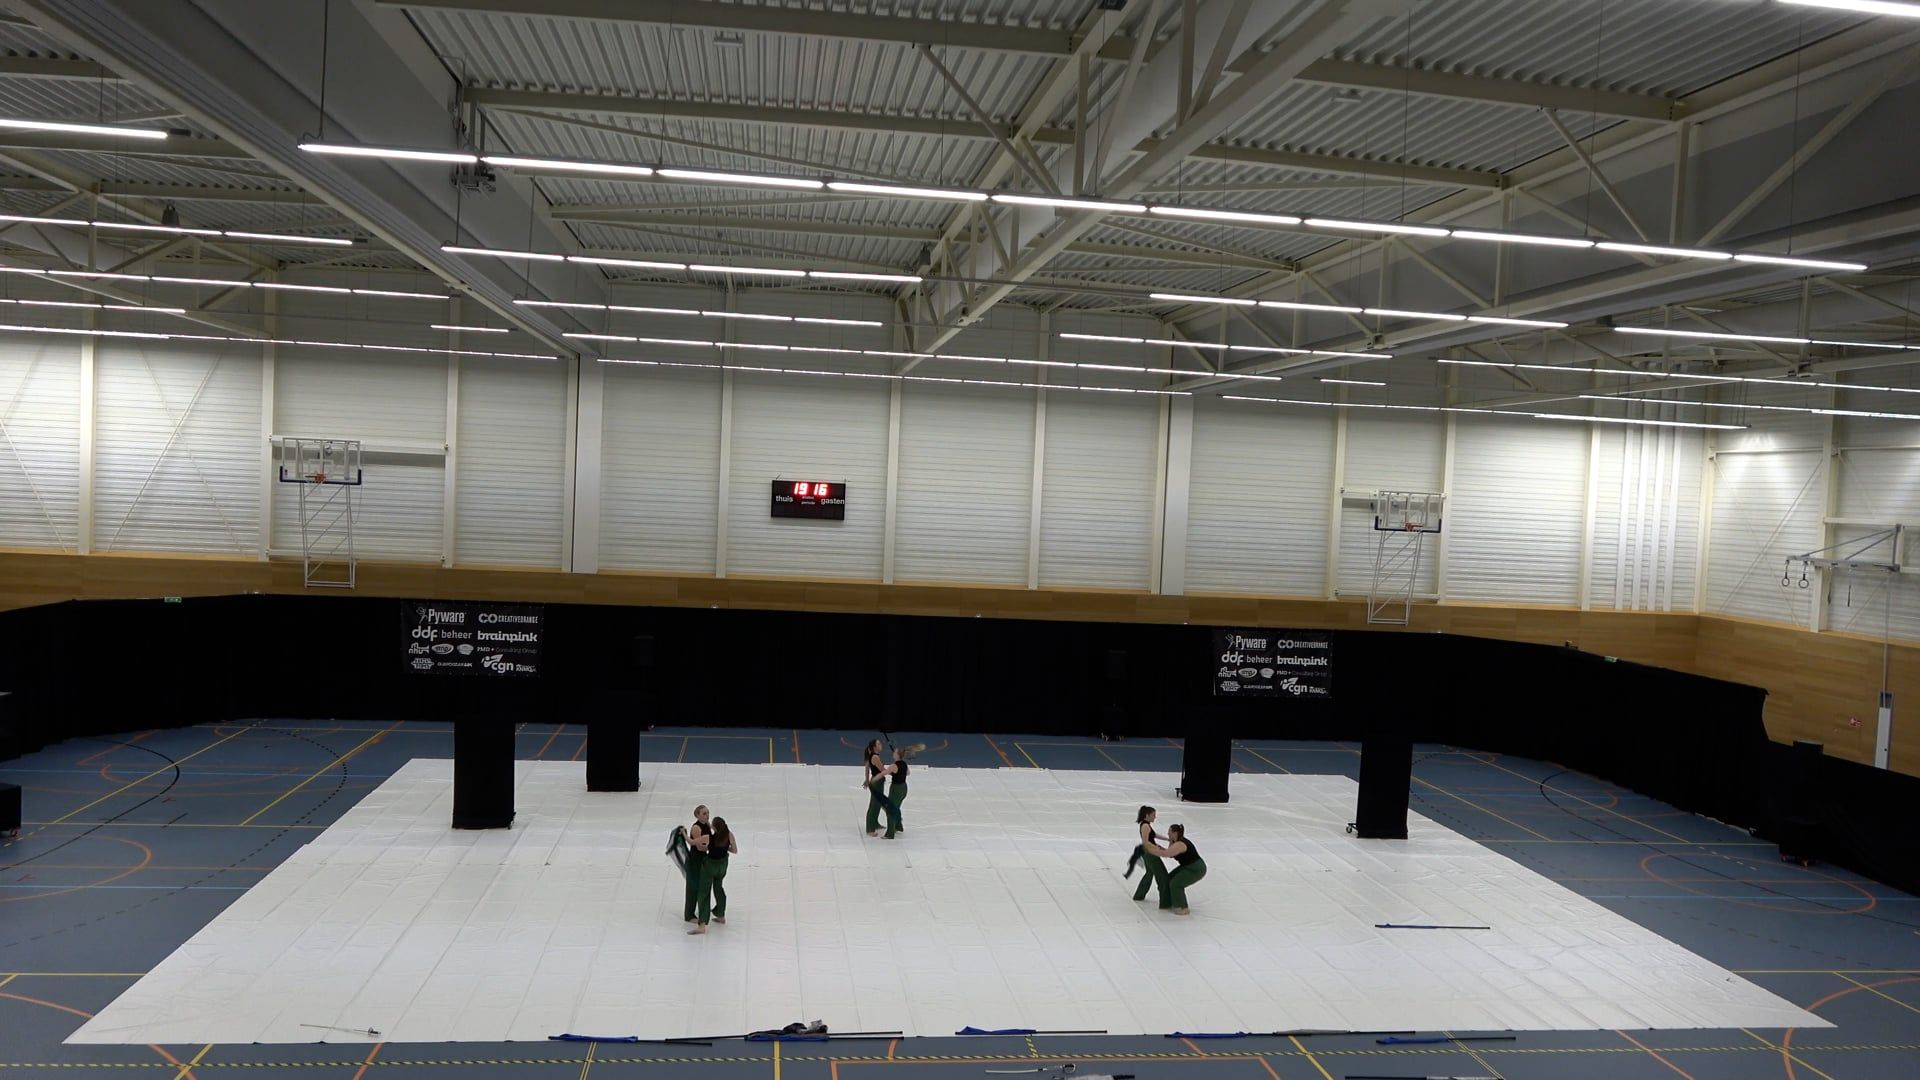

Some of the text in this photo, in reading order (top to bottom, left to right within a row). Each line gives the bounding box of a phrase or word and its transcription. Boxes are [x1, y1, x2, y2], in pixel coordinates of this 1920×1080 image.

[794, 482, 828, 496] 19 16
[428, 608, 464, 624] Pyware
[411, 625, 472, 642] ddf beheer
[477, 630, 538, 643] brainpink
[1235, 635, 1267, 651] Pyware
[1221, 651, 1273, 666] ddf beheer
[1277, 655, 1328, 667] brainpink
[491, 661, 514, 673] cgn
[1288, 684, 1308, 695] cgn
